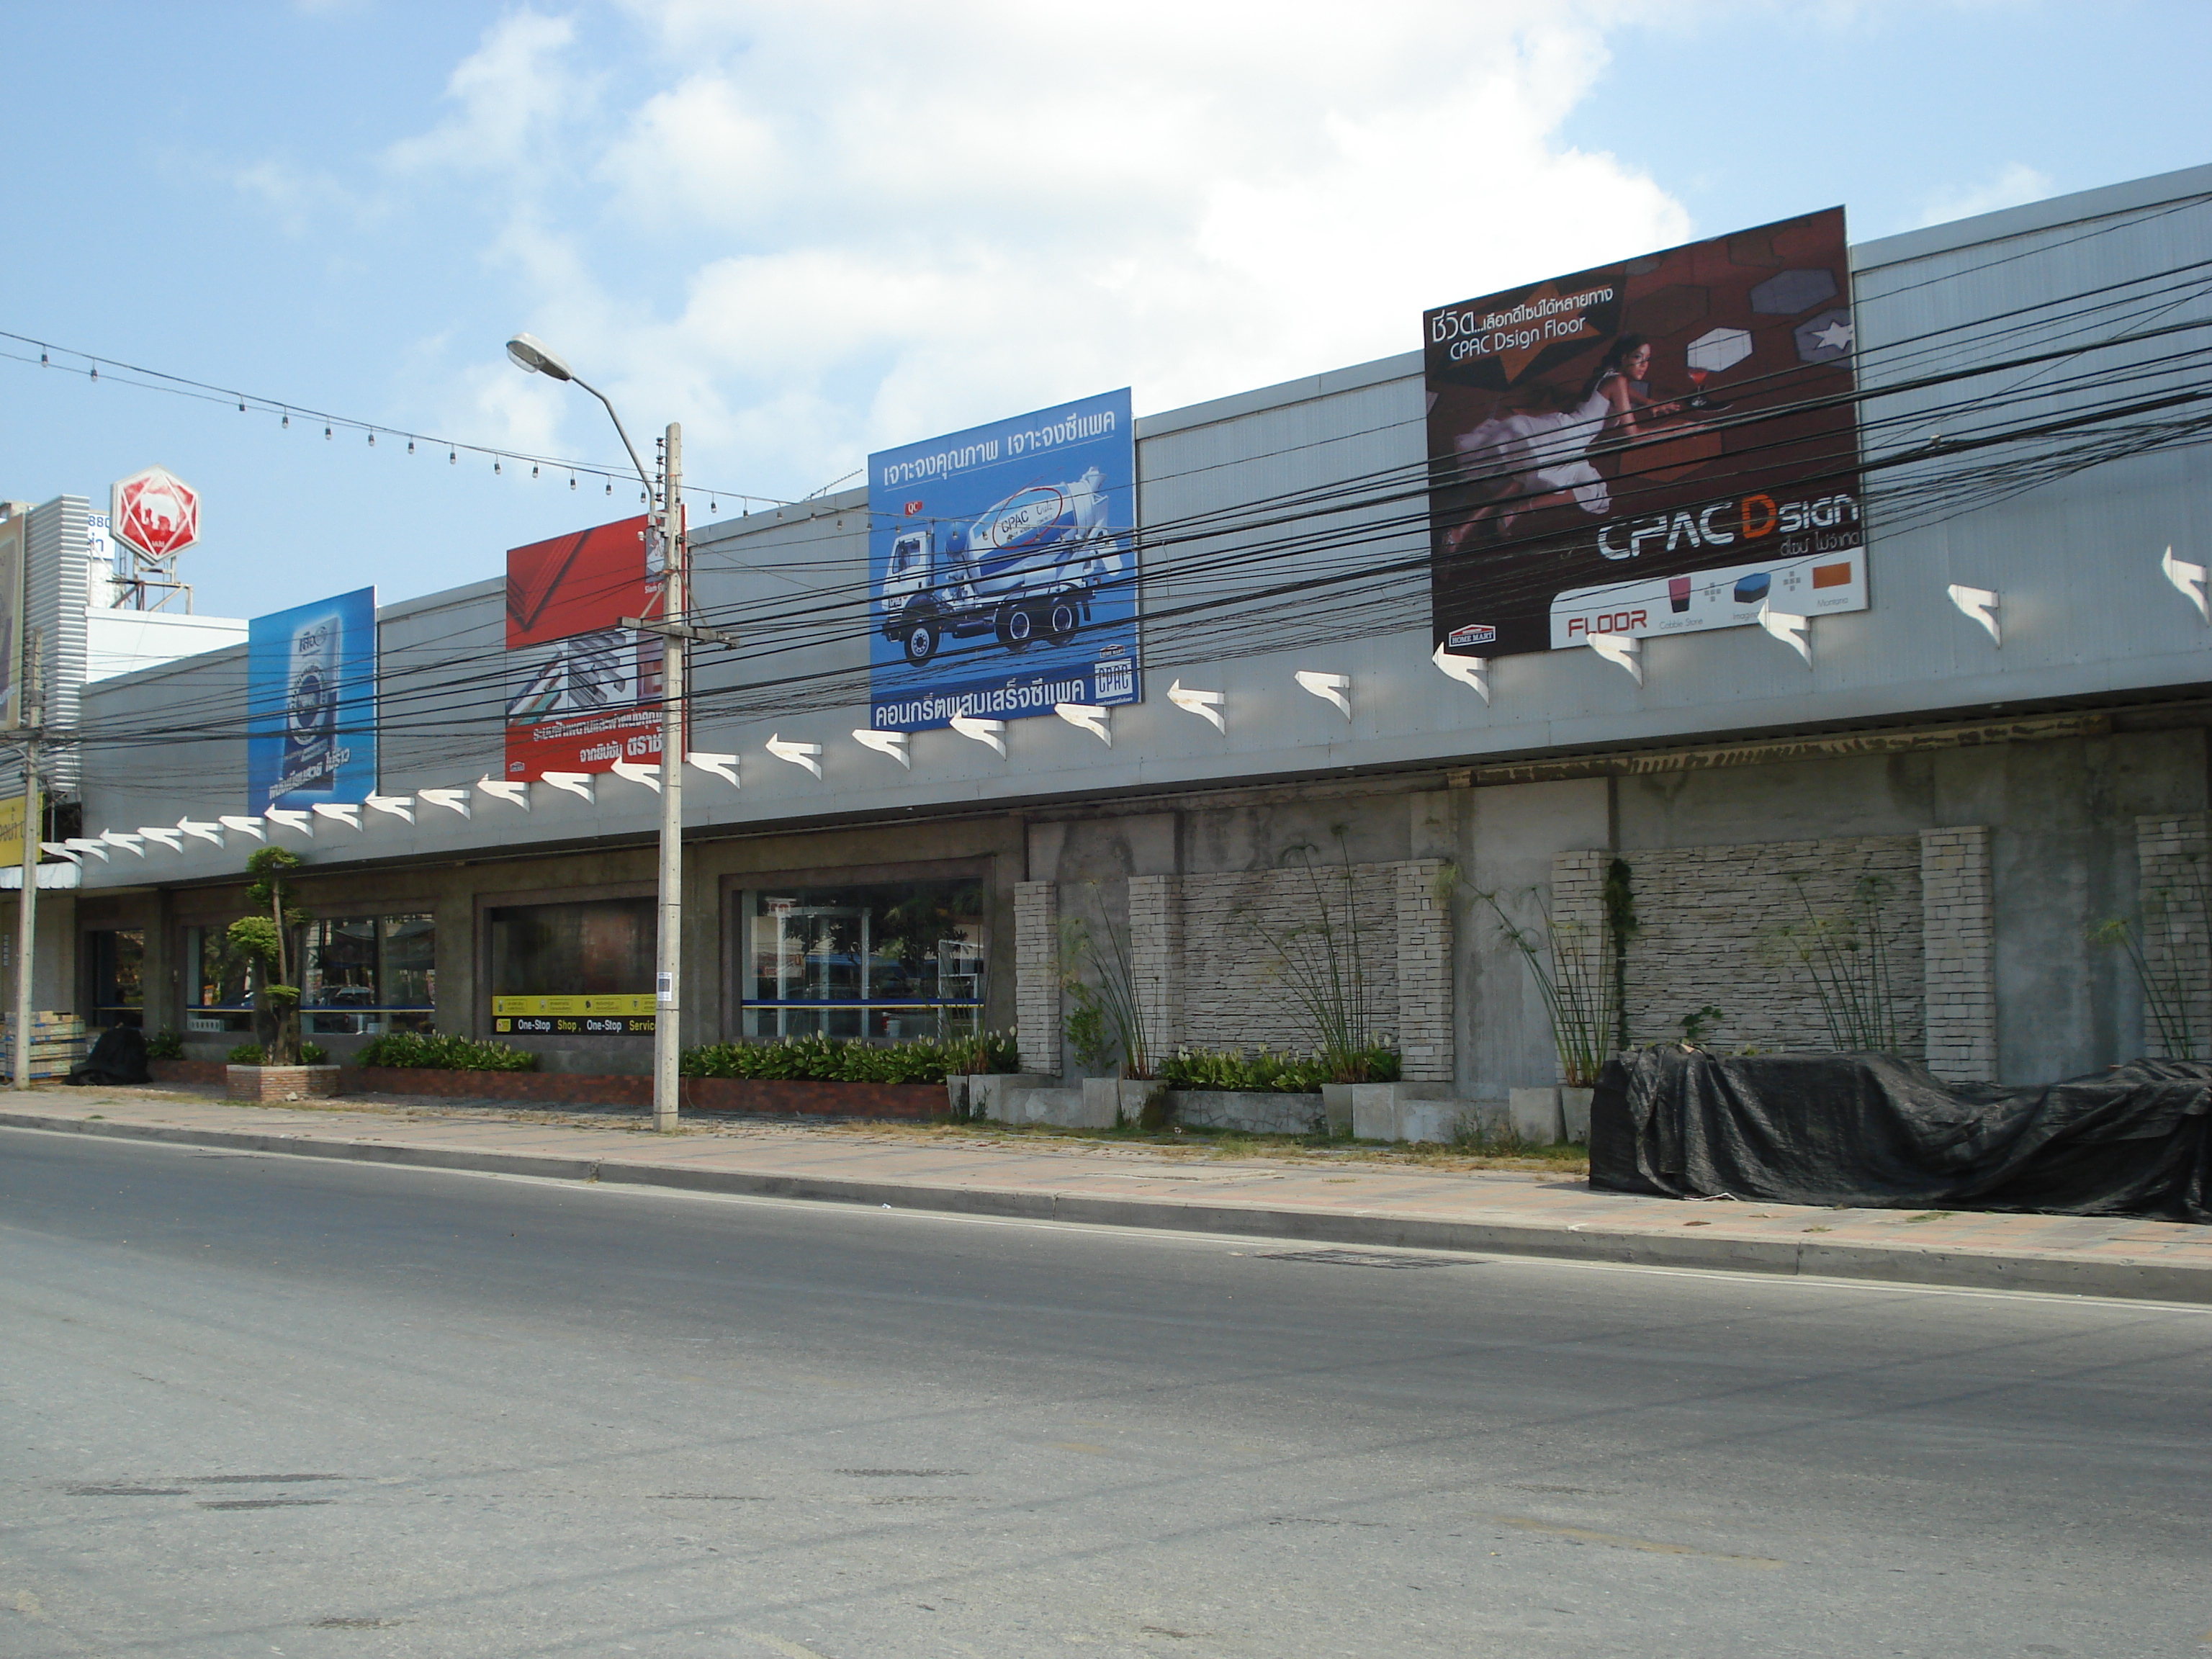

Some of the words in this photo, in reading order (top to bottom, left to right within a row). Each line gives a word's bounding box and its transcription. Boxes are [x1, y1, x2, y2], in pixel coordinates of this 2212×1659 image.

[1449, 335, 1491, 361] CPAC
[1494, 327, 1540, 349] Dsign
[1544, 317, 1586, 339] Floor
[884, 439, 999, 487] เจาะจงคุณภาพ
[1007, 410, 1115, 457] เจาะจงซีแพค
[907, 501, 918, 514] QC
[1001, 510, 1029, 534] CPAC
[1597, 495, 1735, 561] CPAC
[1452, 635, 1473, 644] HOME
[1473, 631, 1493, 641] MART
[1568, 609, 1647, 638] FLOOR
[1099, 664, 1128, 693] CPAC
[518, 1019, 551, 1032] One-Stop
[586, 1019, 622, 1033] One-Stop
[629, 1020, 656, 1032] Servic
